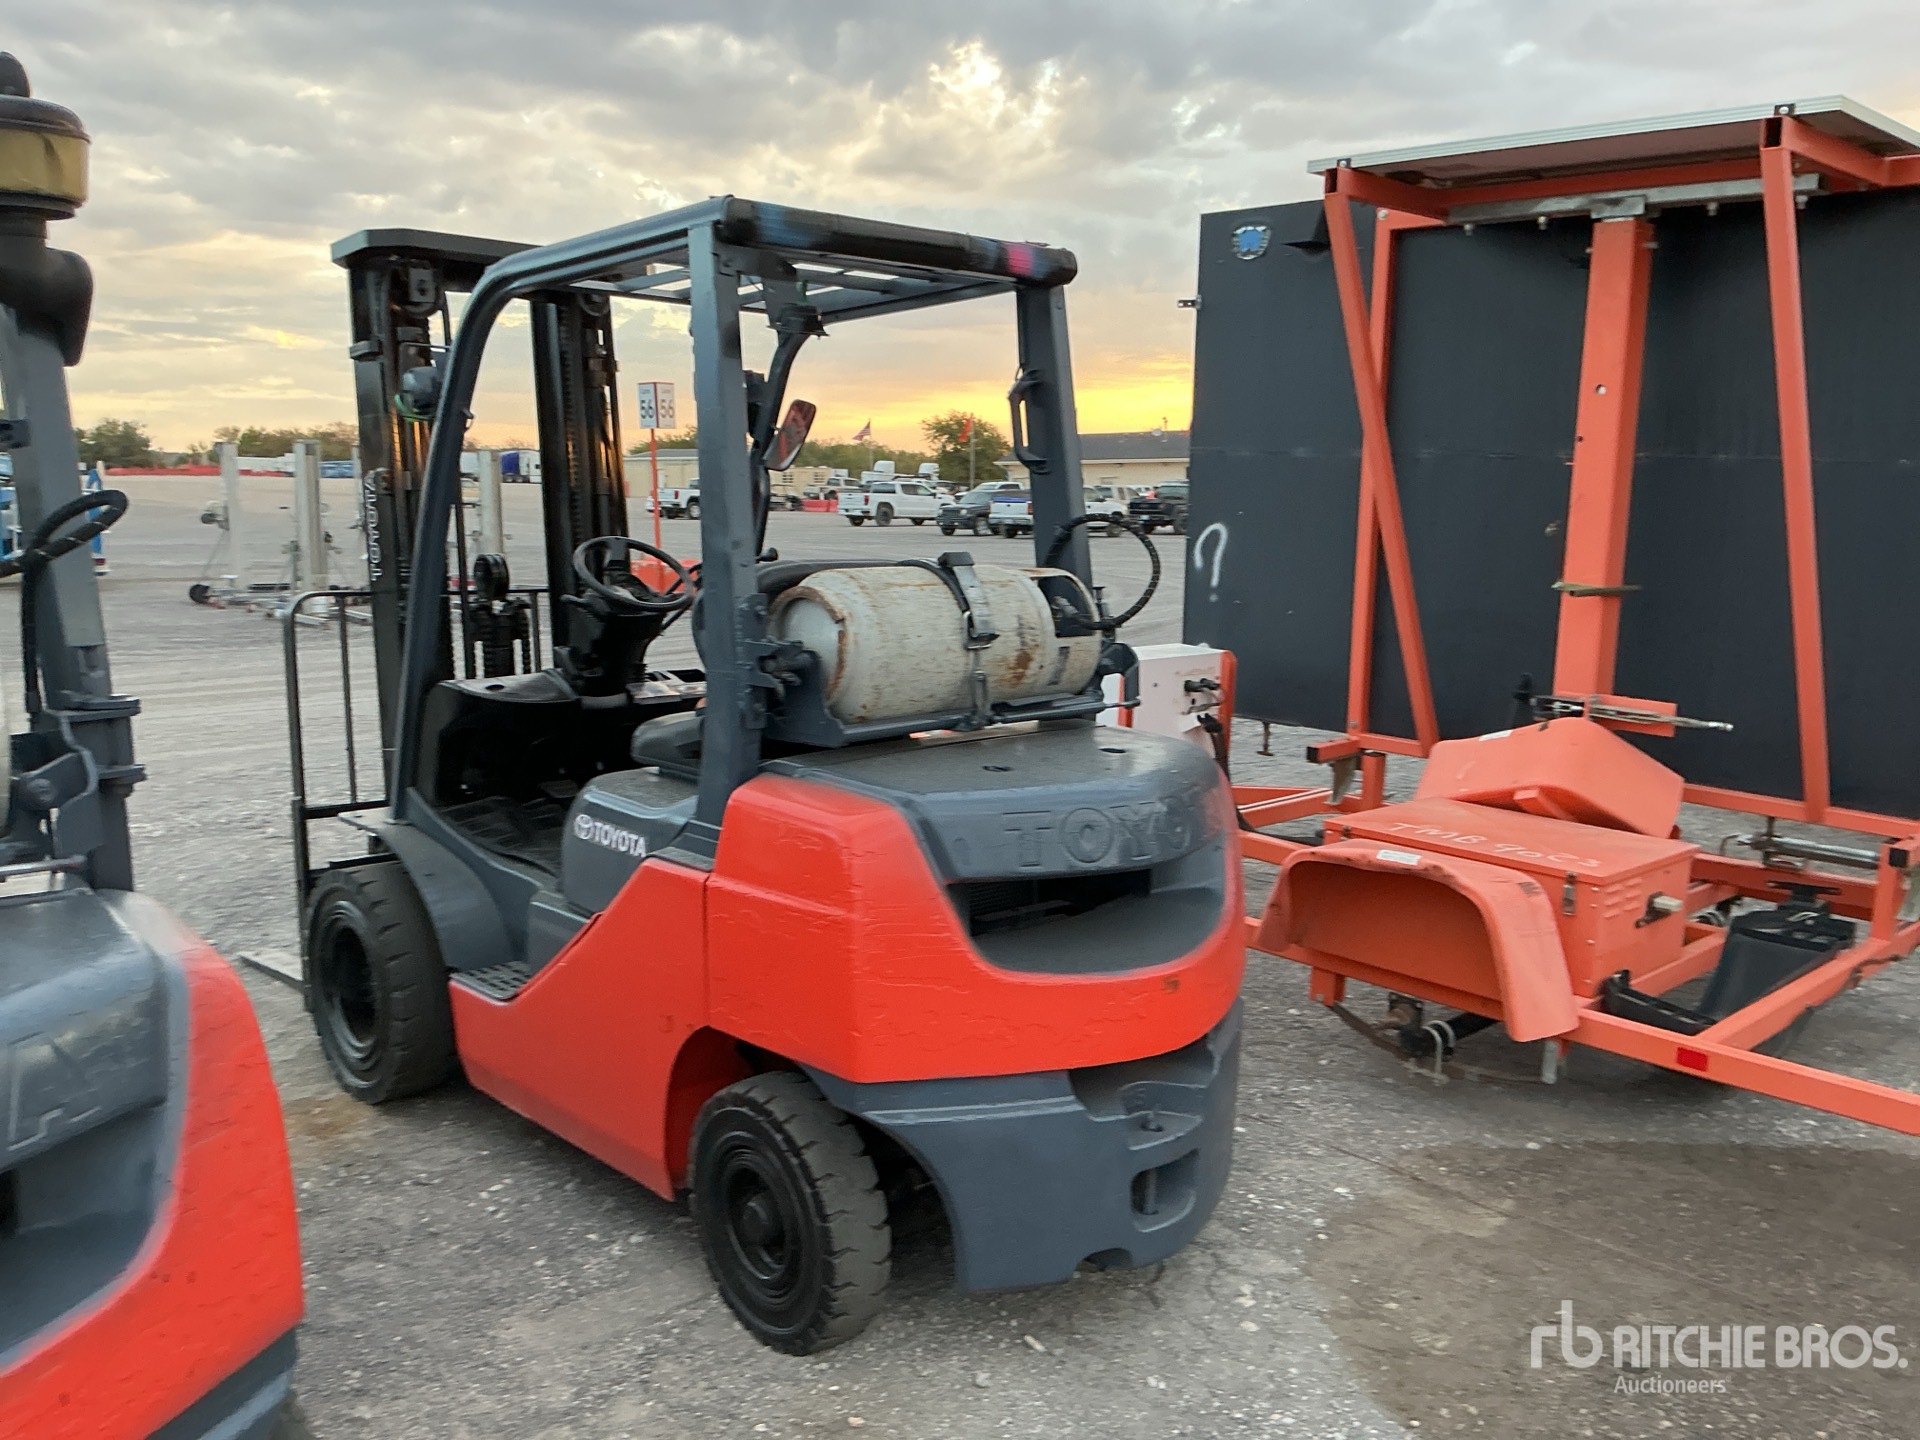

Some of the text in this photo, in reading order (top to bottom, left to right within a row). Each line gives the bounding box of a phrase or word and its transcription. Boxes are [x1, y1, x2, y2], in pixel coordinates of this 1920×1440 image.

[640, 399, 655, 419] 56
[364, 470, 383, 581] TOYOTA
[594, 821, 647, 858] TOYOTA
